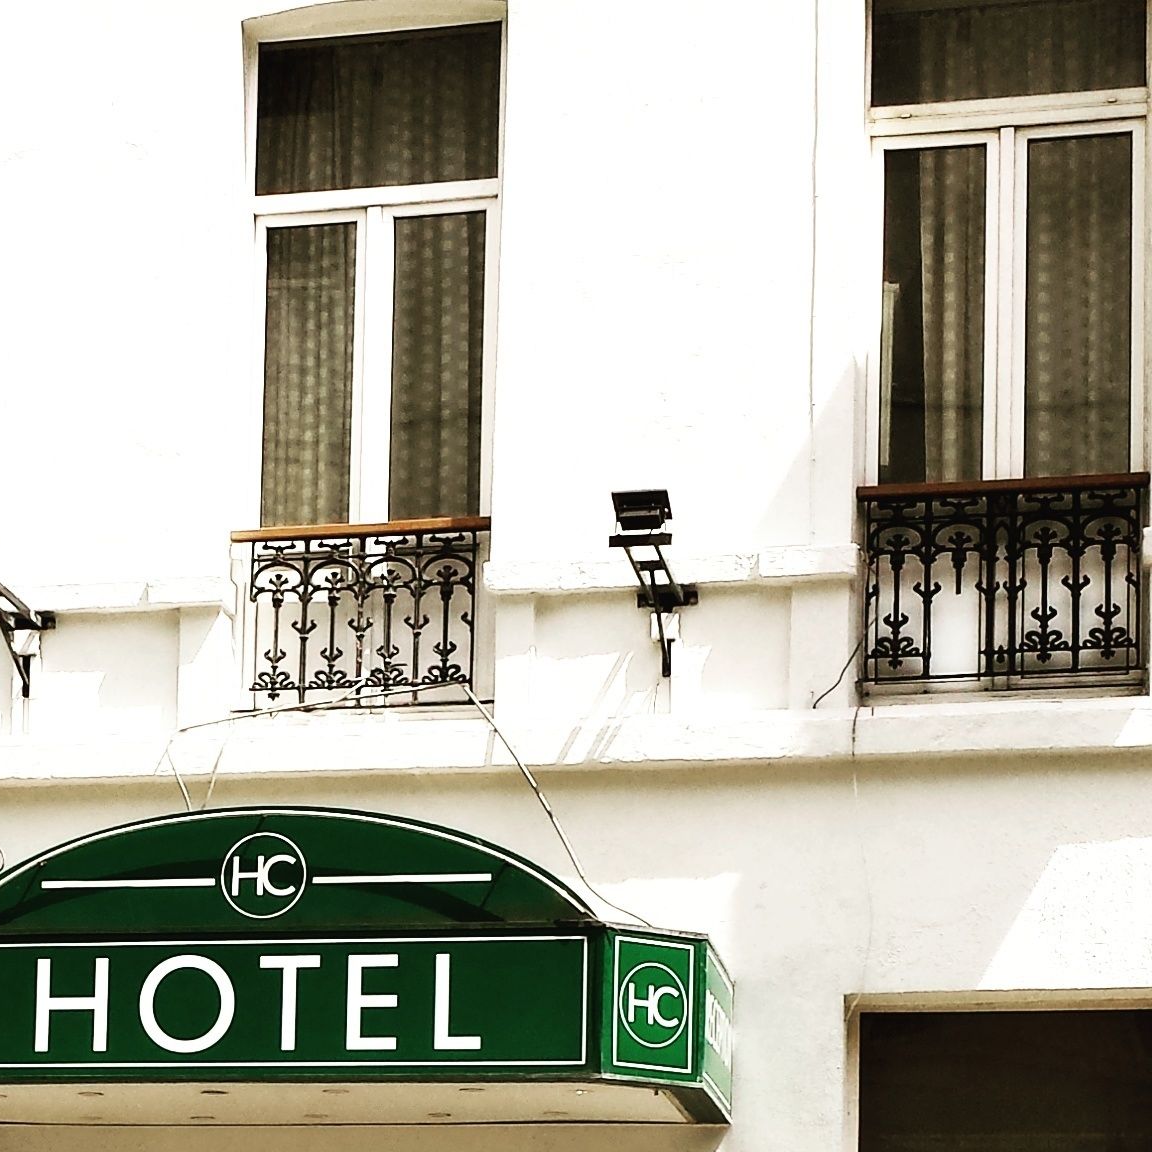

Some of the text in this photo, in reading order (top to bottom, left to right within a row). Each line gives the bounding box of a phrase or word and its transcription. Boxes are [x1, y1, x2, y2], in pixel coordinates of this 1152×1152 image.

[231, 853, 296, 896] HC
[34, 953, 482, 1053] HOTEL
[628, 982, 680, 1028] HC
